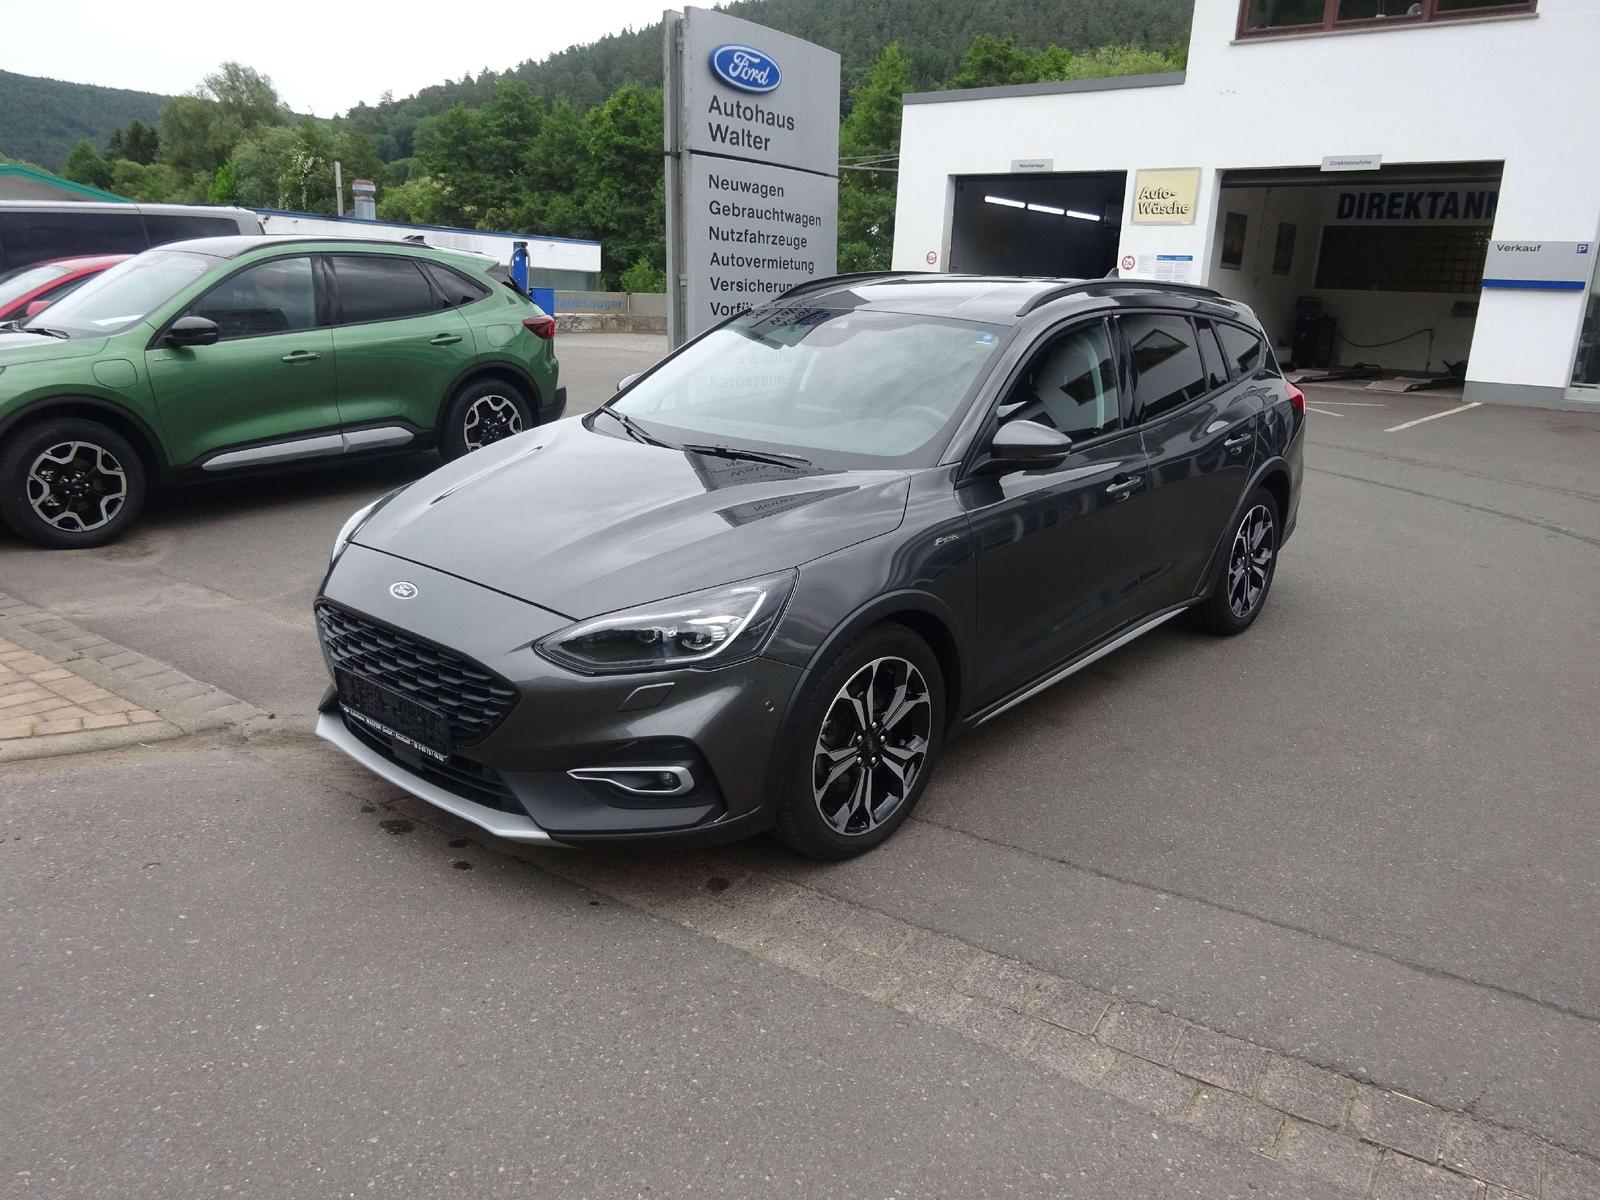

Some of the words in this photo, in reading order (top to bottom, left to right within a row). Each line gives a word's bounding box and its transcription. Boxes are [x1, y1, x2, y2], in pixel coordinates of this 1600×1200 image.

[728, 50, 771, 86] Ford
[708, 95, 795, 131] Autohaus
[708, 122, 771, 151] Walter
[708, 174, 785, 199] Neuwagen
[1138, 186, 1177, 200] Auto-
[708, 200, 822, 229] Gebrauchtwagen
[1138, 200, 1191, 216] Wäsche
[708, 226, 808, 250] Nutzfahrzeuge
[1496, 243, 1543, 253] Verkauf
[709, 252, 815, 275] Autovermietung
[710, 277, 799, 293] Versicherun
